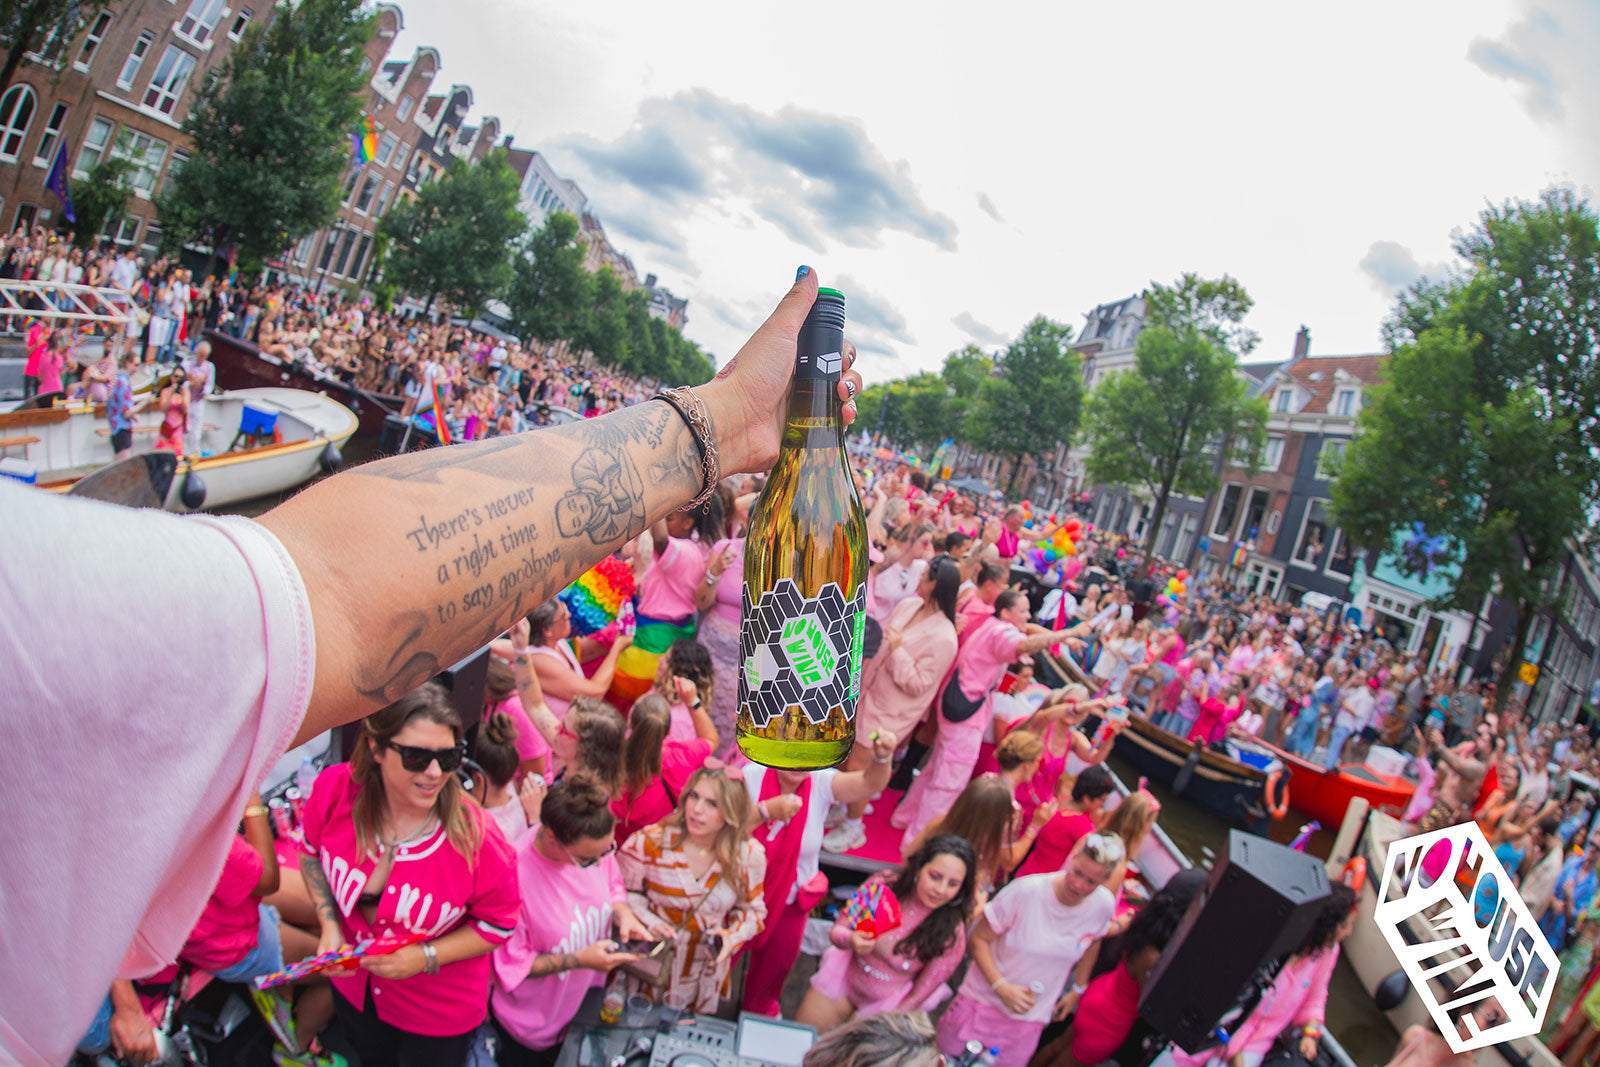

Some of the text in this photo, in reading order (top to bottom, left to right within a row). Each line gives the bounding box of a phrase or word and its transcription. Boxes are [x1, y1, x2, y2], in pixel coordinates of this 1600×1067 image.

[406, 486, 536, 552] There's never
[437, 522, 539, 584] a right time
[436, 600, 456, 624] to
[462, 583, 494, 609] say
[782, 618, 807, 639] NO
[806, 619, 835, 678] HOUSE
[786, 638, 822, 687] WINE
